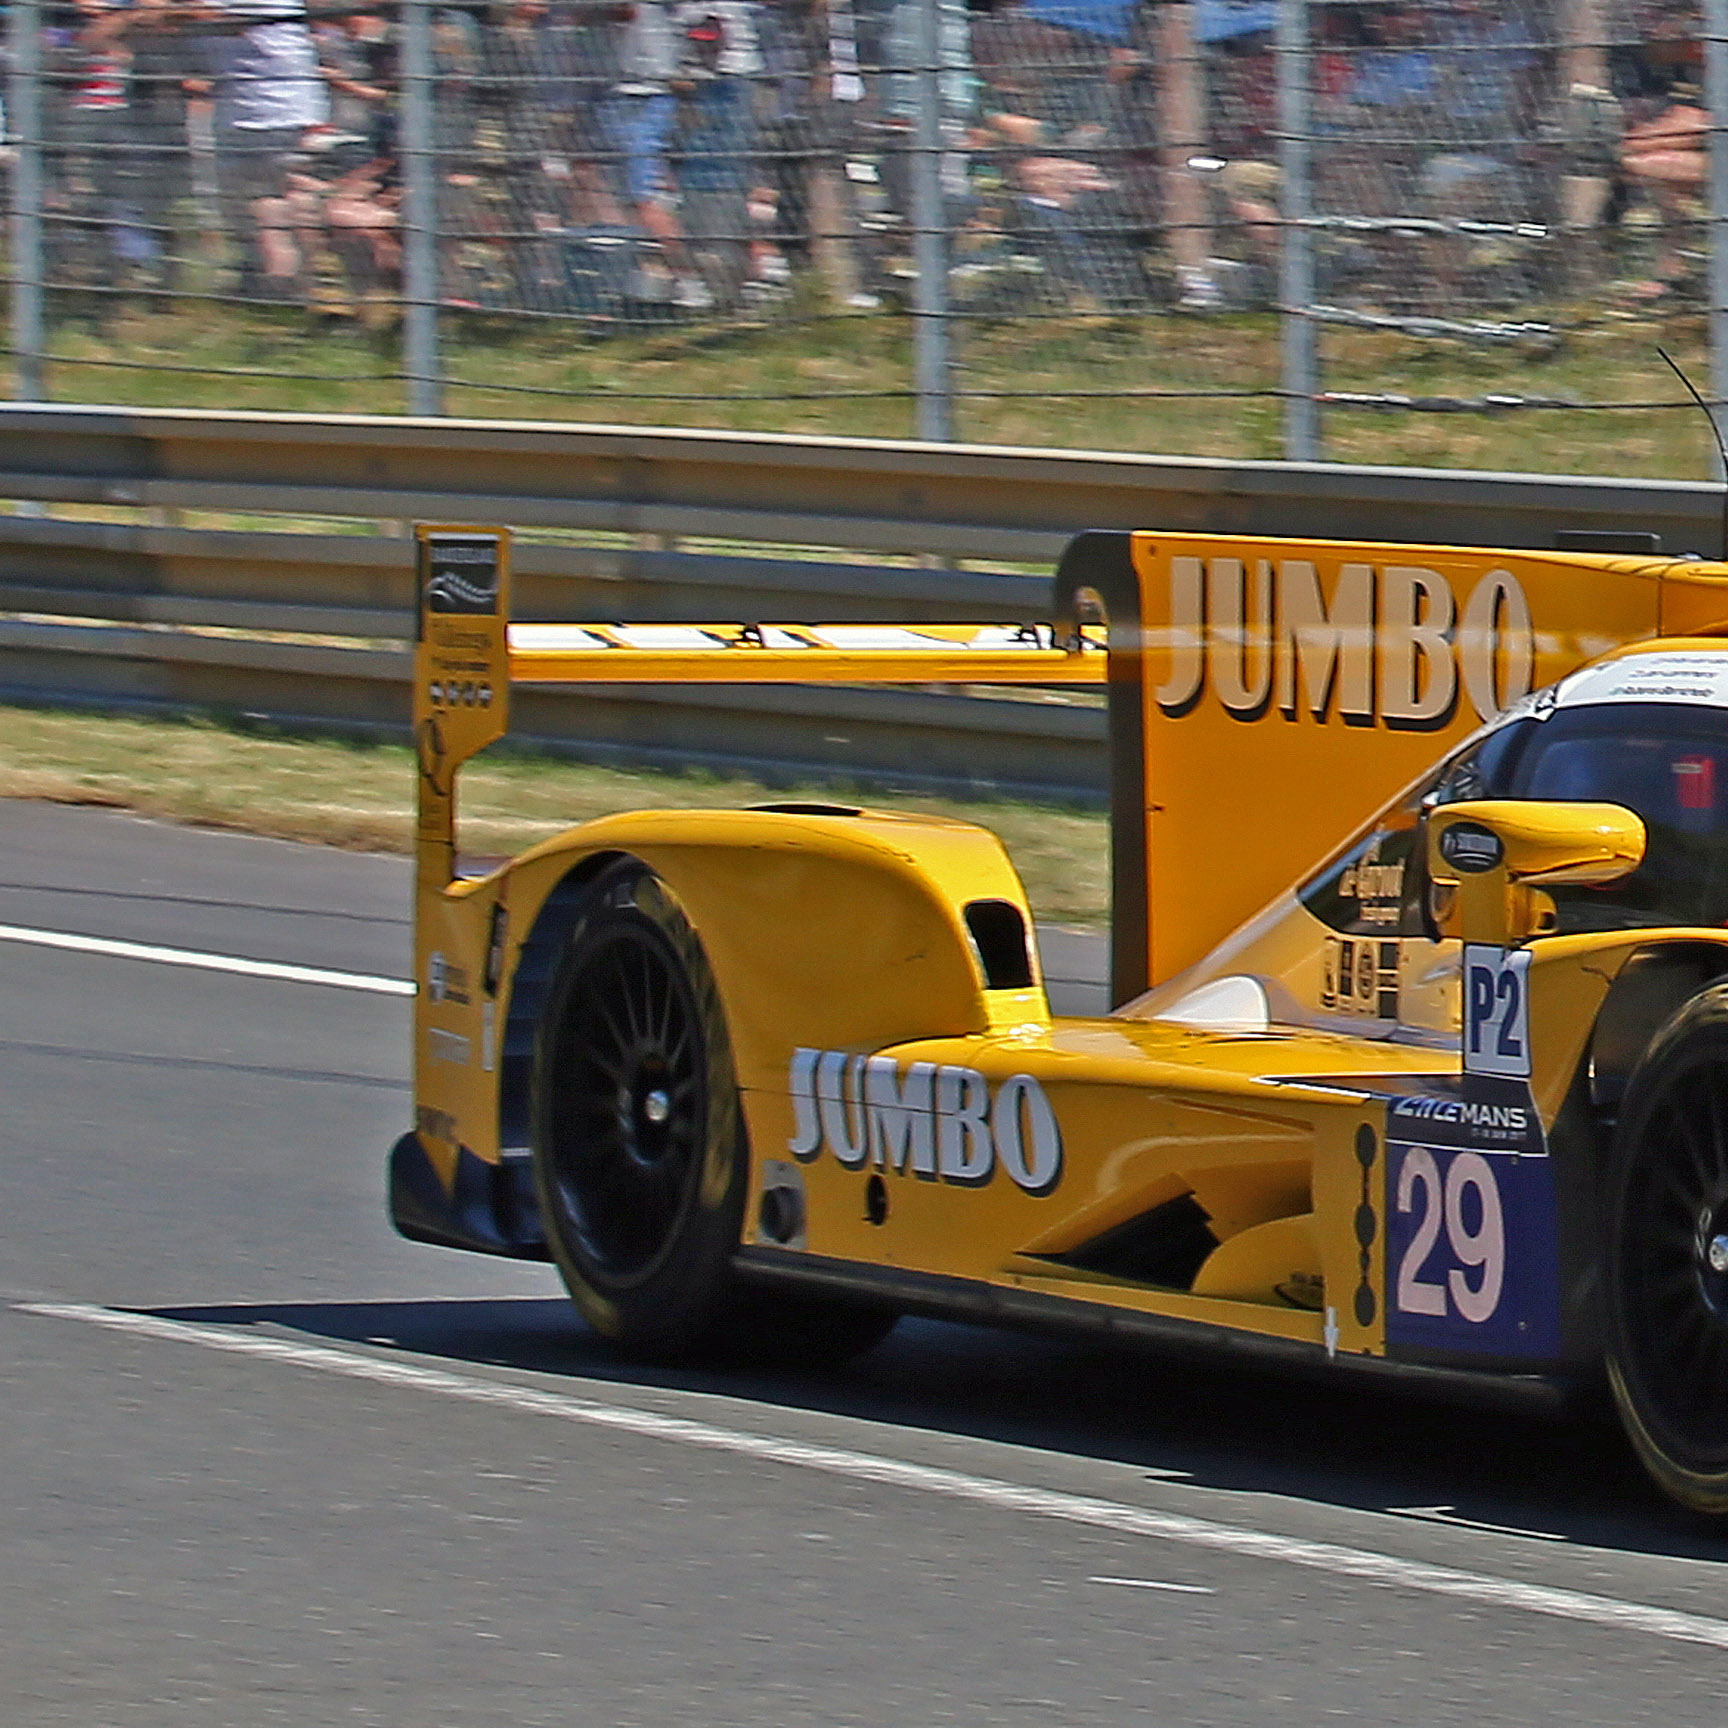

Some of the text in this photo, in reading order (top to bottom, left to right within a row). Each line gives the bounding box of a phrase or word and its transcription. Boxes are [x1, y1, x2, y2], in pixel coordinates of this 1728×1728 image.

[1154, 555, 1534, 732] JUMBO
[1470, 965, 1523, 1058] P2
[787, 1046, 1063, 1197] JUMBO
[1397, 1146, 1506, 1323] 29
